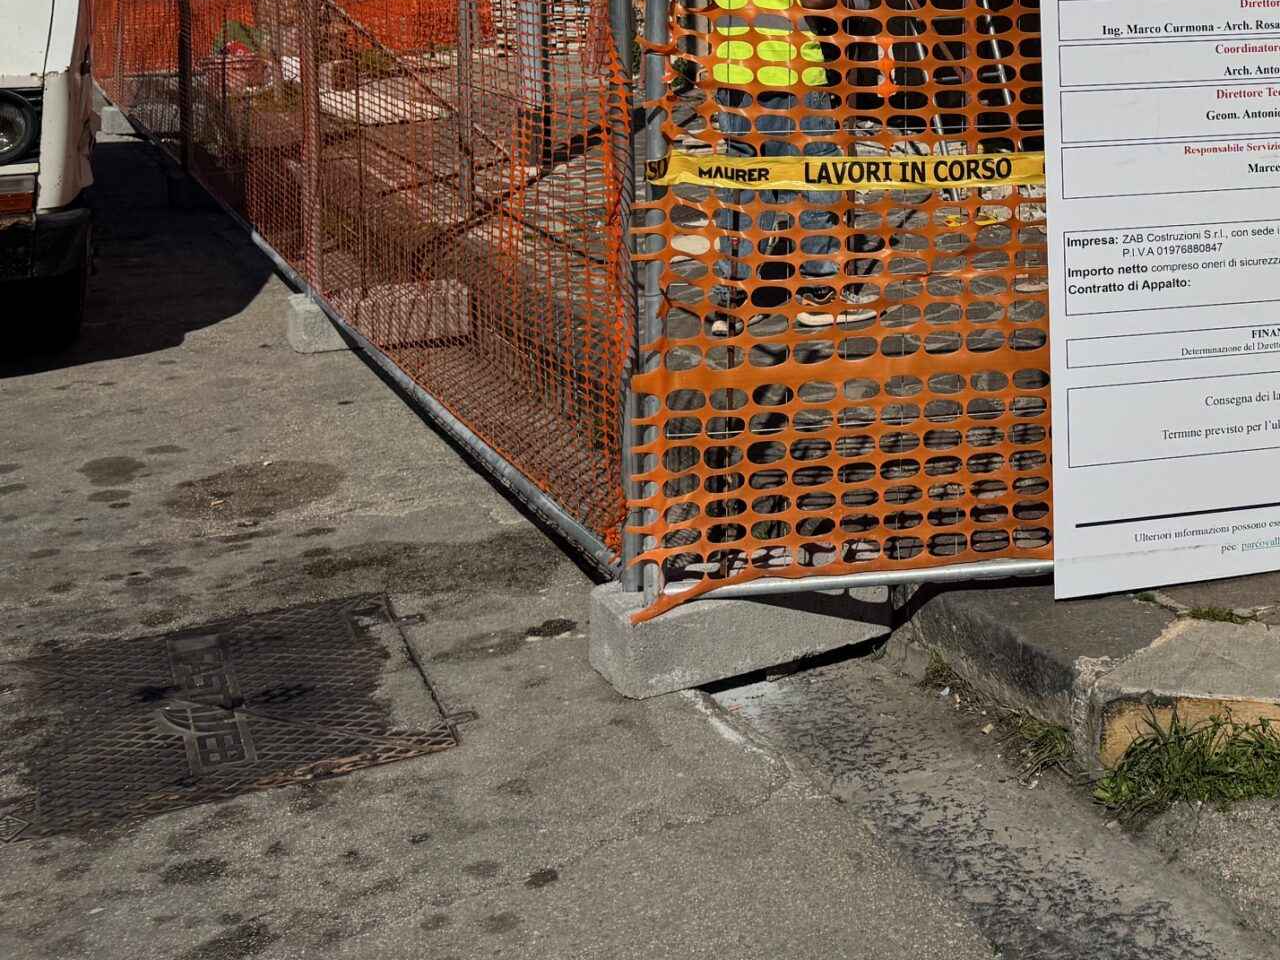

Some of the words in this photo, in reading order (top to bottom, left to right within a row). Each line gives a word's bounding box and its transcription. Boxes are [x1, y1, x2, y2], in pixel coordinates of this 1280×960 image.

[1101, 24, 1123, 38] Ing.
[1126, 23, 1161, 34] Marco
[1223, 19, 1253, 31] Arch.
[1223, 64, 1253, 76] Arch.
[1215, 87, 1263, 99] Direttore
[1205, 109, 1240, 120] Geom.
[1183, 143, 1244, 156] Responsabile
[698, 166, 770, 182] MAURER
[804, 160, 892, 185] LAVORI
[899, 161, 927, 183] IN
[933, 157, 1012, 183] CORSO
[1066, 236, 1118, 249] Impresa:
[1121, 232, 1144, 244] ZAB
[1145, 231, 1201, 243] Costruzioni
[1230, 228, 1248, 237] con
[1251, 227, 1274, 236] sede
[1067, 265, 1114, 279] Importo
[1117, 263, 1148, 275] netto
[1150, 261, 1199, 273] compreso
[1200, 258, 1226, 269] oneri
[1227, 257, 1237, 268] di
[1067, 282, 1124, 295] Contratto
[1126, 279, 1139, 291] di
[1140, 277, 1191, 292] Appalto:
[1204, 394, 1253, 407] Consegna
[1254, 391, 1270, 402] dei
[1161, 428, 1202, 440] Termine
[1204, 423, 1244, 439] previsto
[1245, 422, 1262, 435] per
